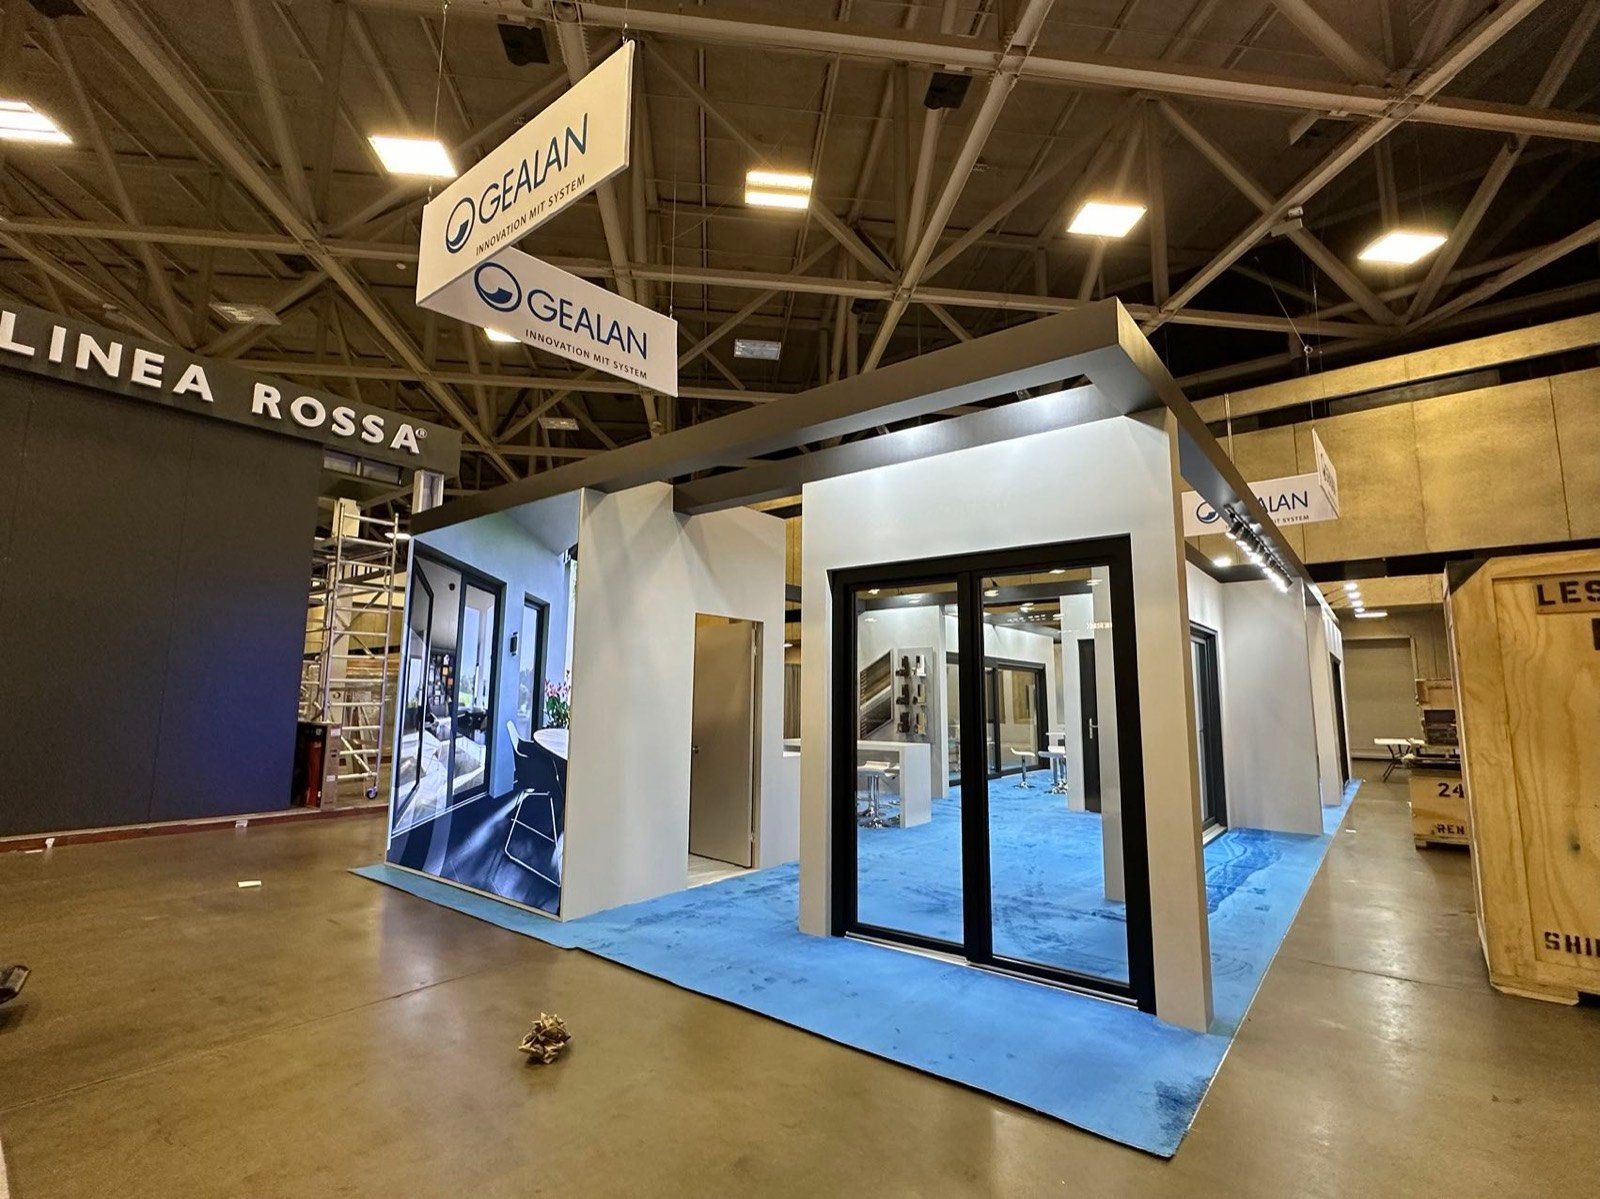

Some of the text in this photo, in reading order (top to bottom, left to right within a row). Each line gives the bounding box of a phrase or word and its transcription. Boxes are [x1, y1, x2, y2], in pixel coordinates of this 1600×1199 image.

[478, 112, 588, 225] GEALAN
[476, 174, 586, 257] INNOVATION MIT SYSTEM
[1, 310, 214, 403] LINEA
[525, 329, 648, 380] INNOVATION MIT SYSTEM
[527, 288, 648, 360] GEALAN
[1282, 514, 1310, 523] SYSTEM
[1438, 782, 1465, 799] 24
